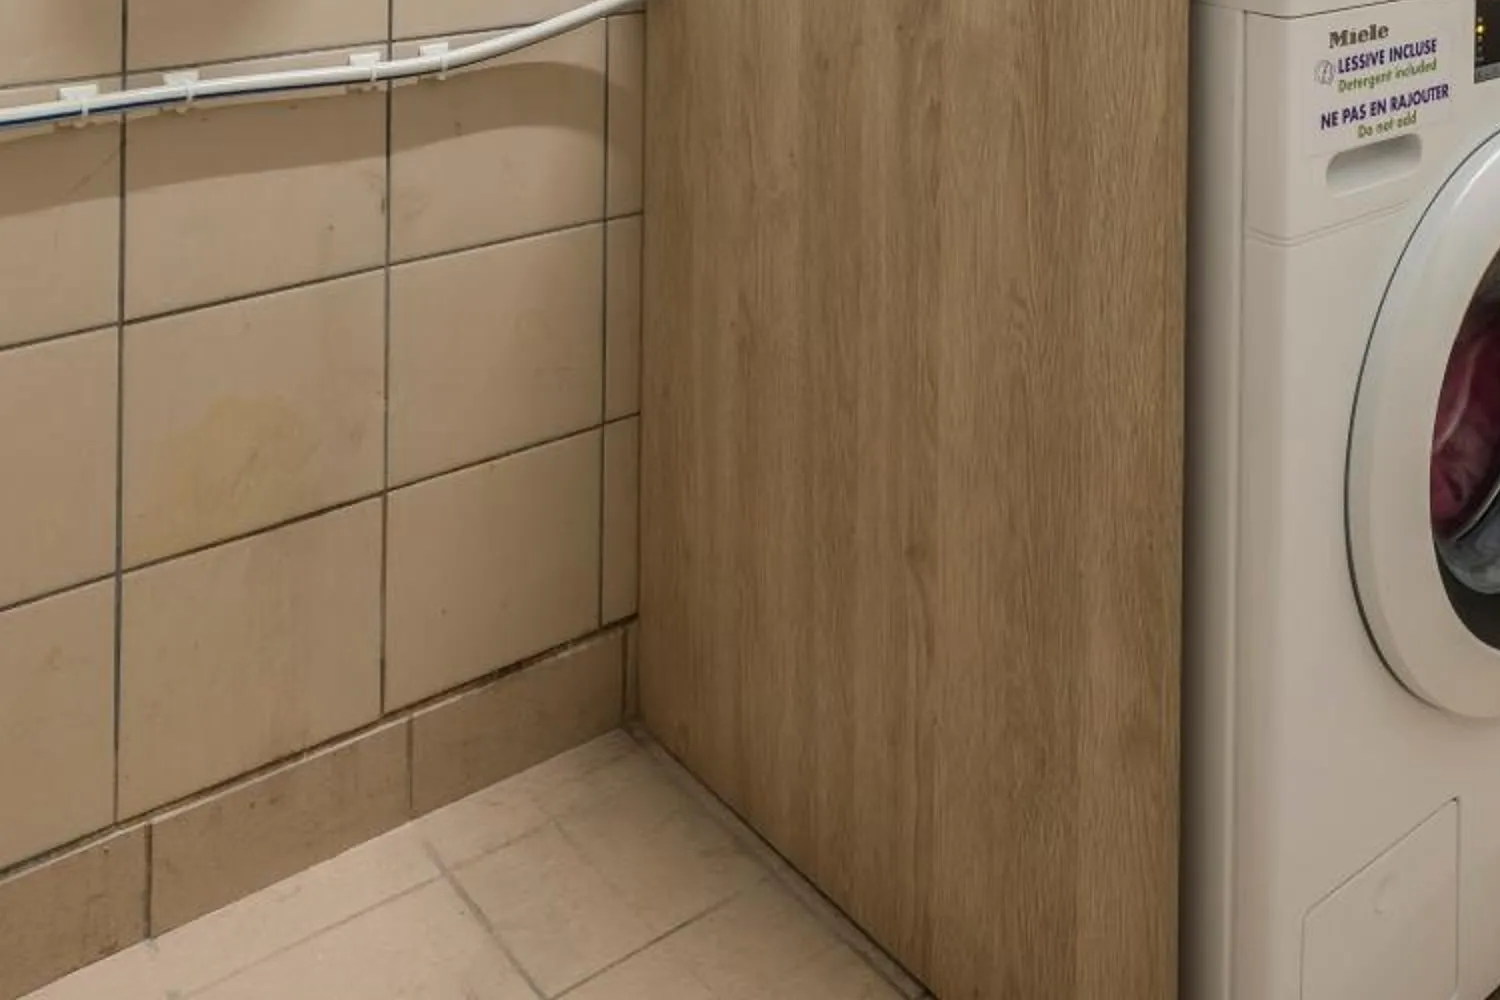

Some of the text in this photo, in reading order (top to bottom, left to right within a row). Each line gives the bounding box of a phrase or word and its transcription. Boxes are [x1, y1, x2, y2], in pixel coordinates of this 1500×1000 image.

[1328, 23, 1390, 50] Miele
[1337, 37, 1438, 75] LESSIVE INCLUSE
[1338, 57, 1438, 93] Detergent included
[1320, 82, 1450, 131] NE PAS EN RAJOUTER
[1357, 110, 1418, 139] Do not add
